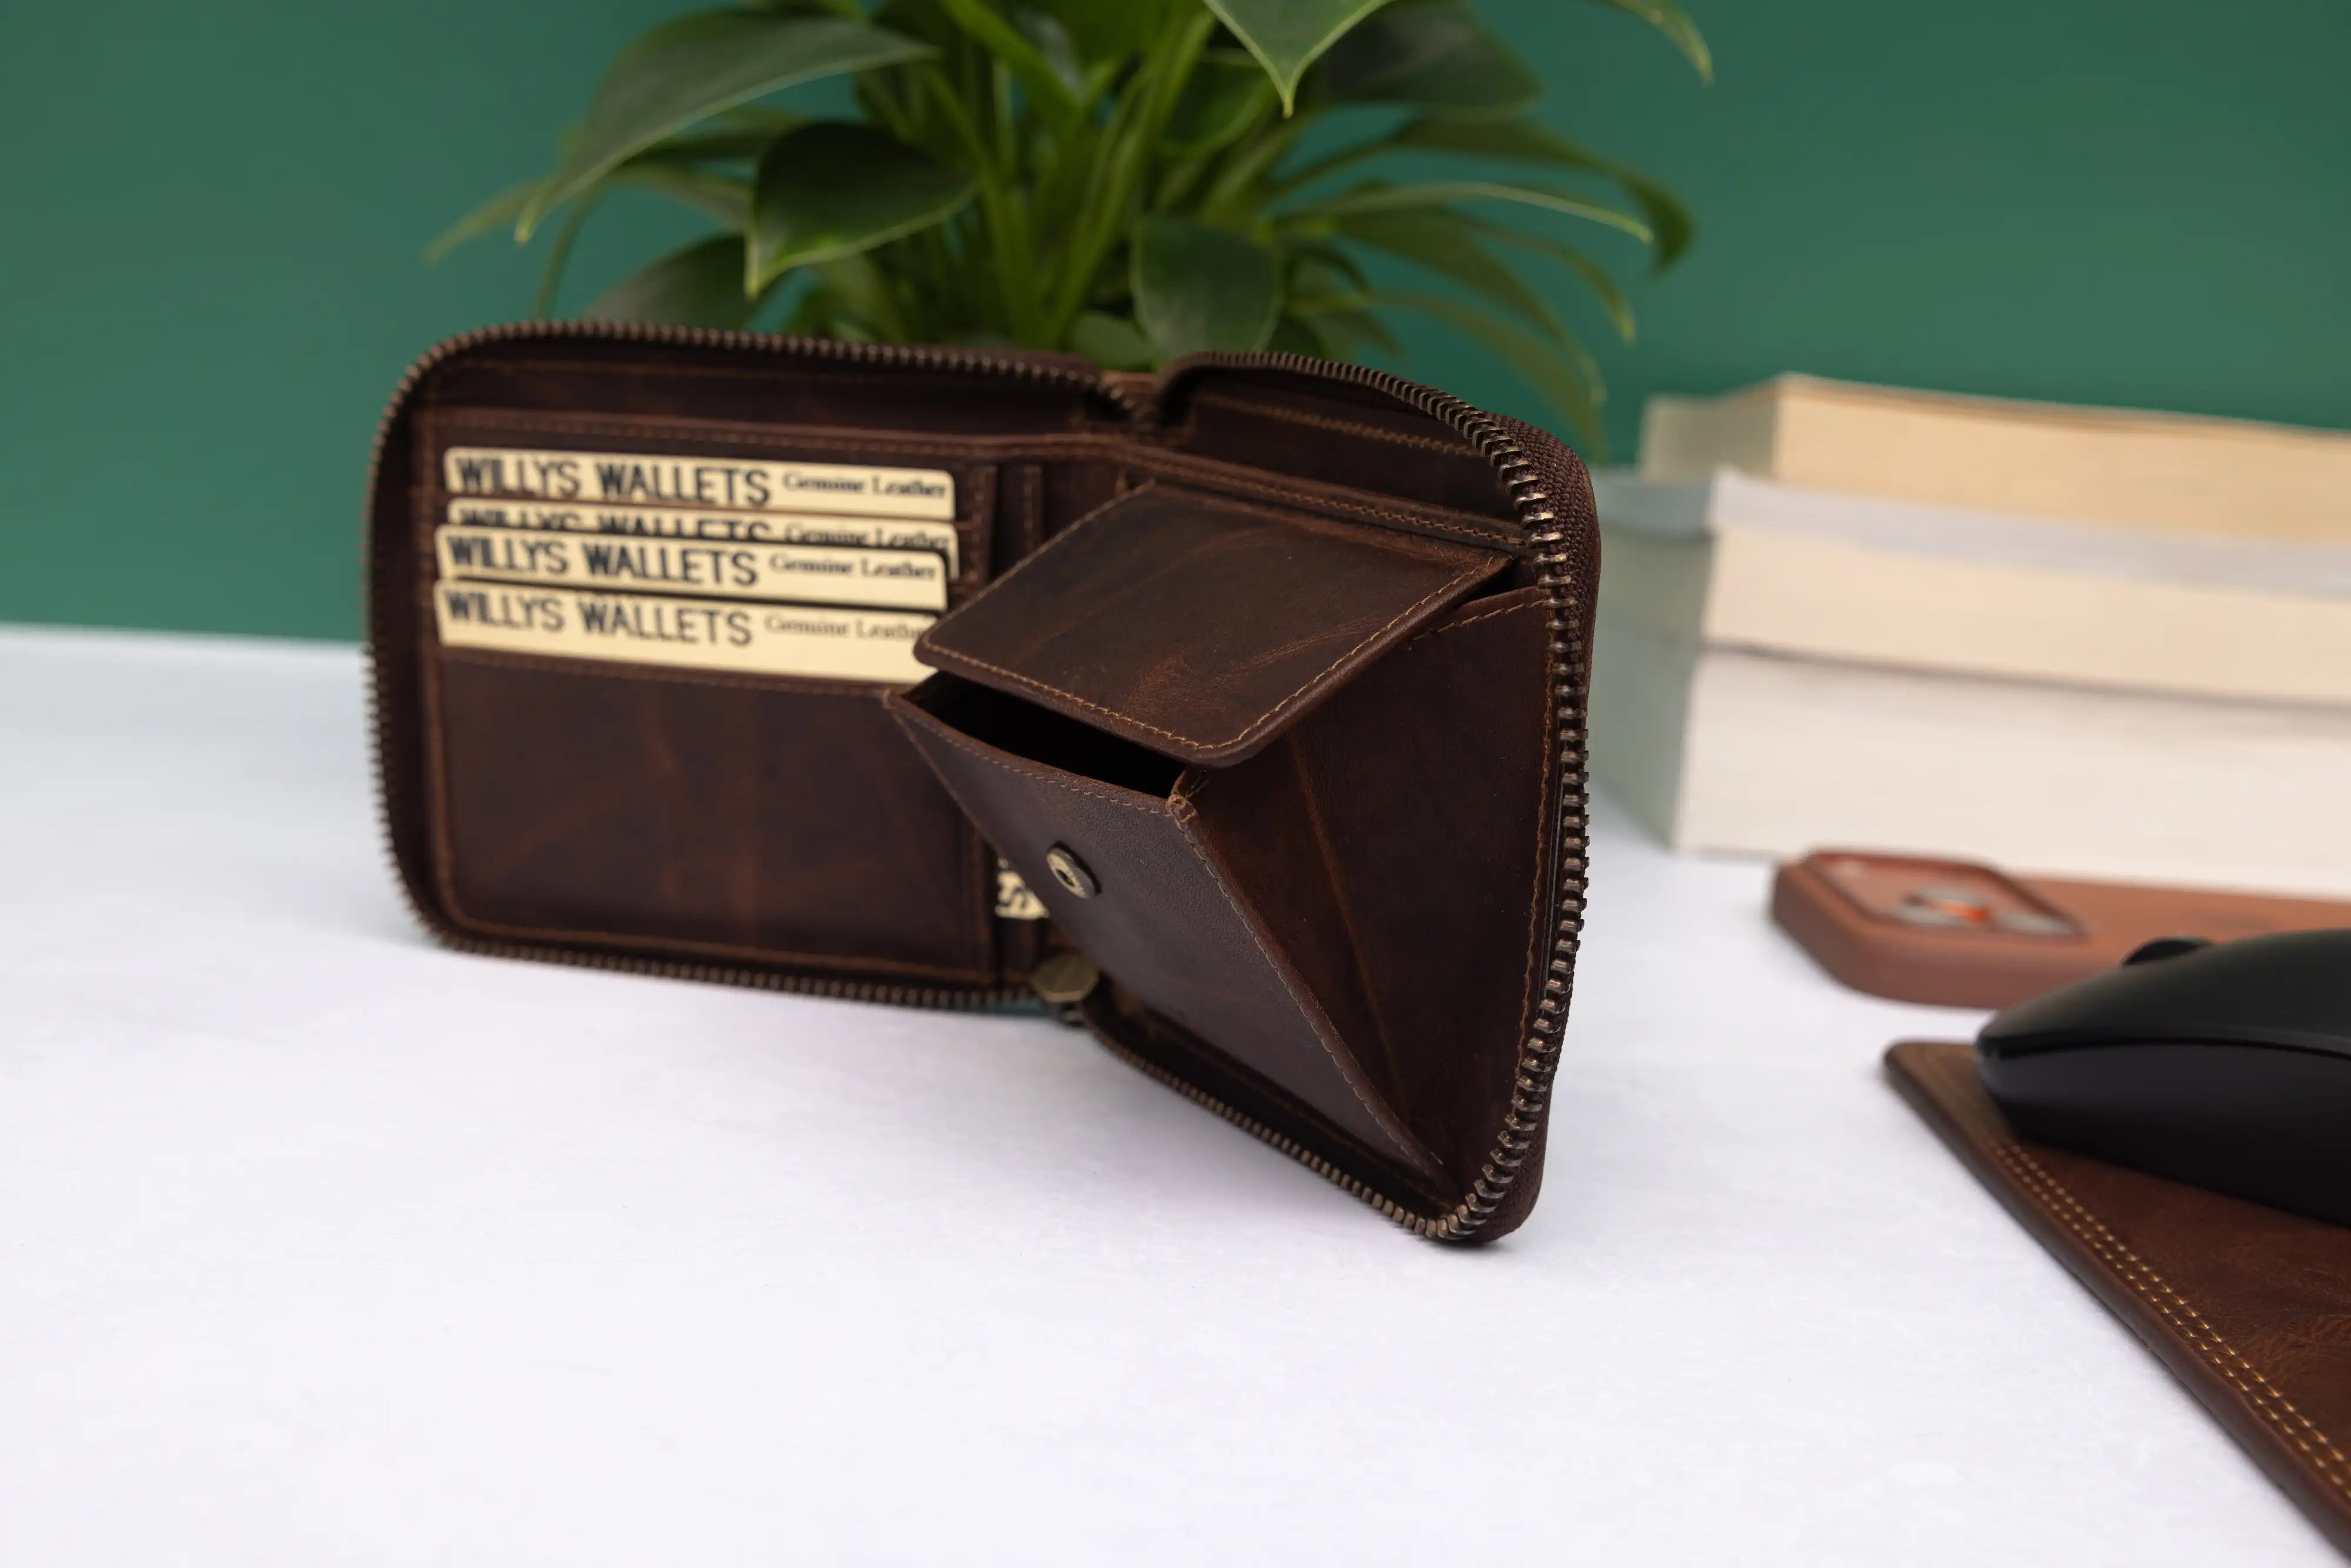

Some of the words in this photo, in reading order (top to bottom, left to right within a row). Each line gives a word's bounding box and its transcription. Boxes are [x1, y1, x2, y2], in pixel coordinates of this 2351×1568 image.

[455, 458, 581, 496] WILLYS
[594, 463, 772, 507] WALLETS
[782, 471, 865, 492] Genuine
[872, 476, 945, 497] Leather
[446, 536, 569, 574] WILLYS
[582, 542, 758, 587] WALLETS
[769, 552, 853, 575] Genuine
[861, 558, 936, 579] Leather
[443, 591, 565, 632] WILLYS
[578, 599, 753, 646] WALLETS
[764, 614, 847, 635] Genuine
